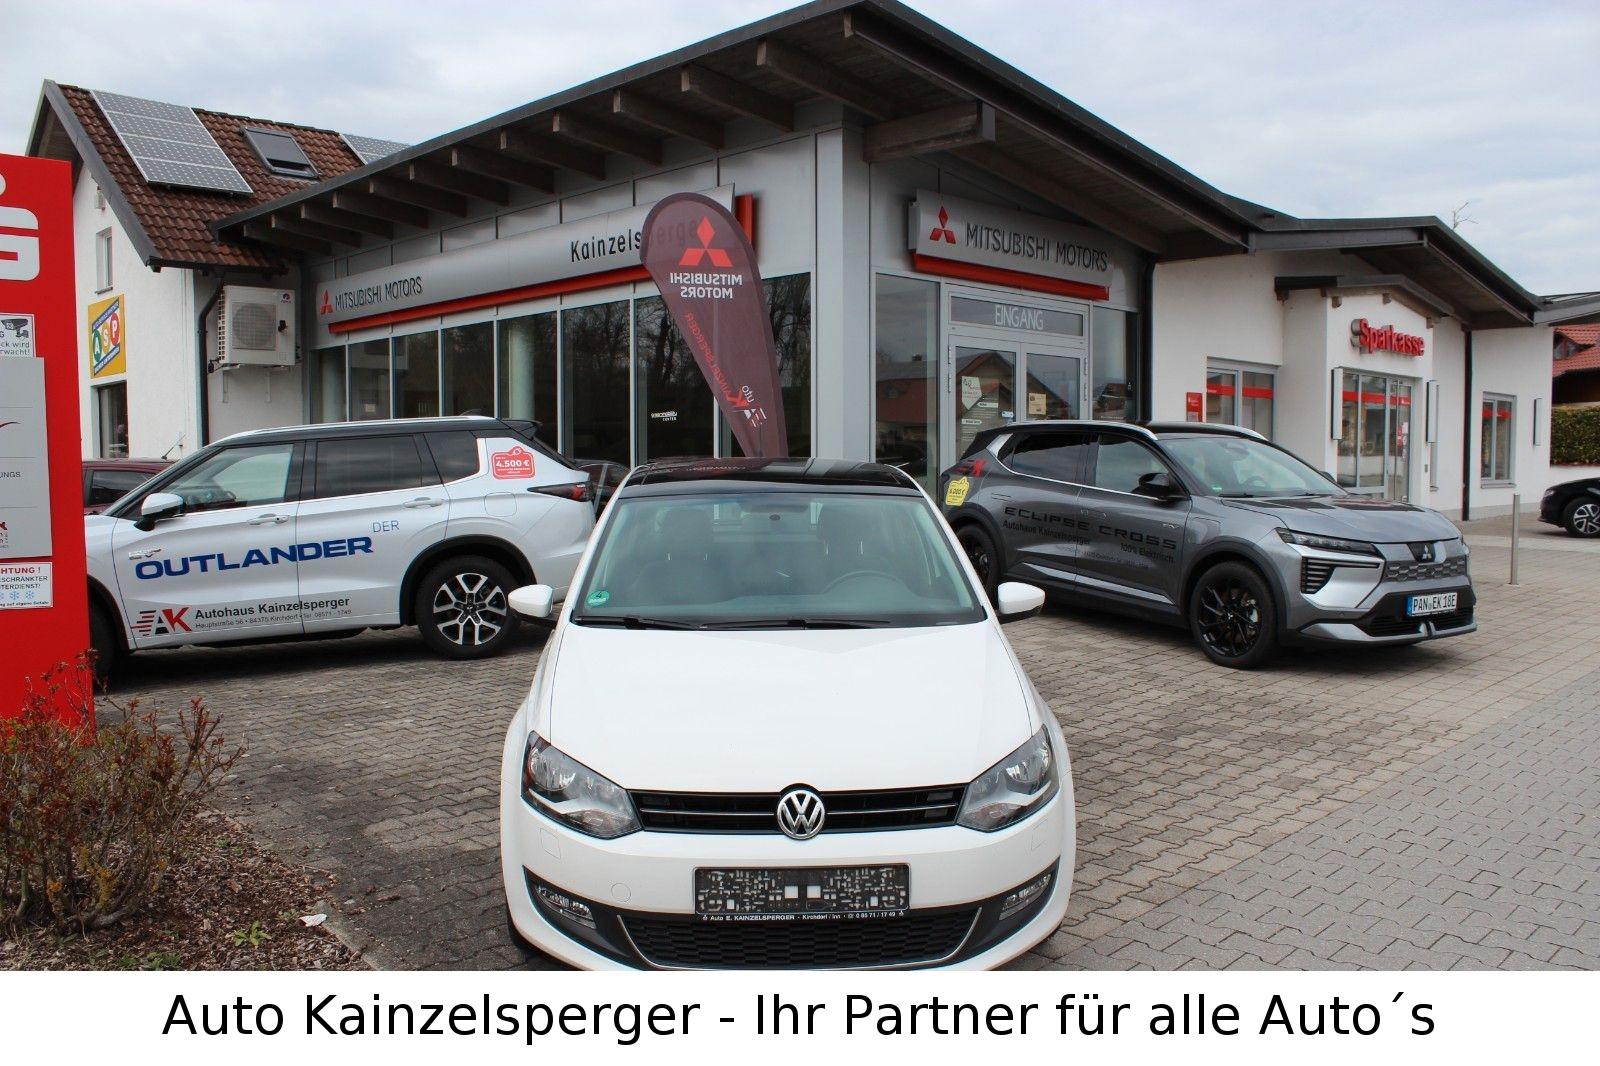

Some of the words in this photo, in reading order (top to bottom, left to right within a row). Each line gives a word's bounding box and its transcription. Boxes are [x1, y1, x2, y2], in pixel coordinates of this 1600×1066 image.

[966, 223, 1050, 261] MITSUBISHI
[1056, 242, 1109, 272] MOTORS
[335, 284, 382, 311] MITSUBISHI
[385, 276, 423, 301] MOTORS
[994, 305, 1045, 331] EINGANG
[1358, 318, 1425, 356] Sparkasse
[372, 520, 400, 533] DER
[1005, 507, 1090, 531] ECLIPSE
[1099, 525, 1177, 550] CROSS
[135, 536, 374, 580] OUTLANDER
[195, 606, 255, 620] Autohaus
[258, 598, 350, 614] Kainzelsperger
[1413, 598, 1428, 612] PAN
[1432, 596, 1442, 609] EK
[777, 789, 825, 840] VW
